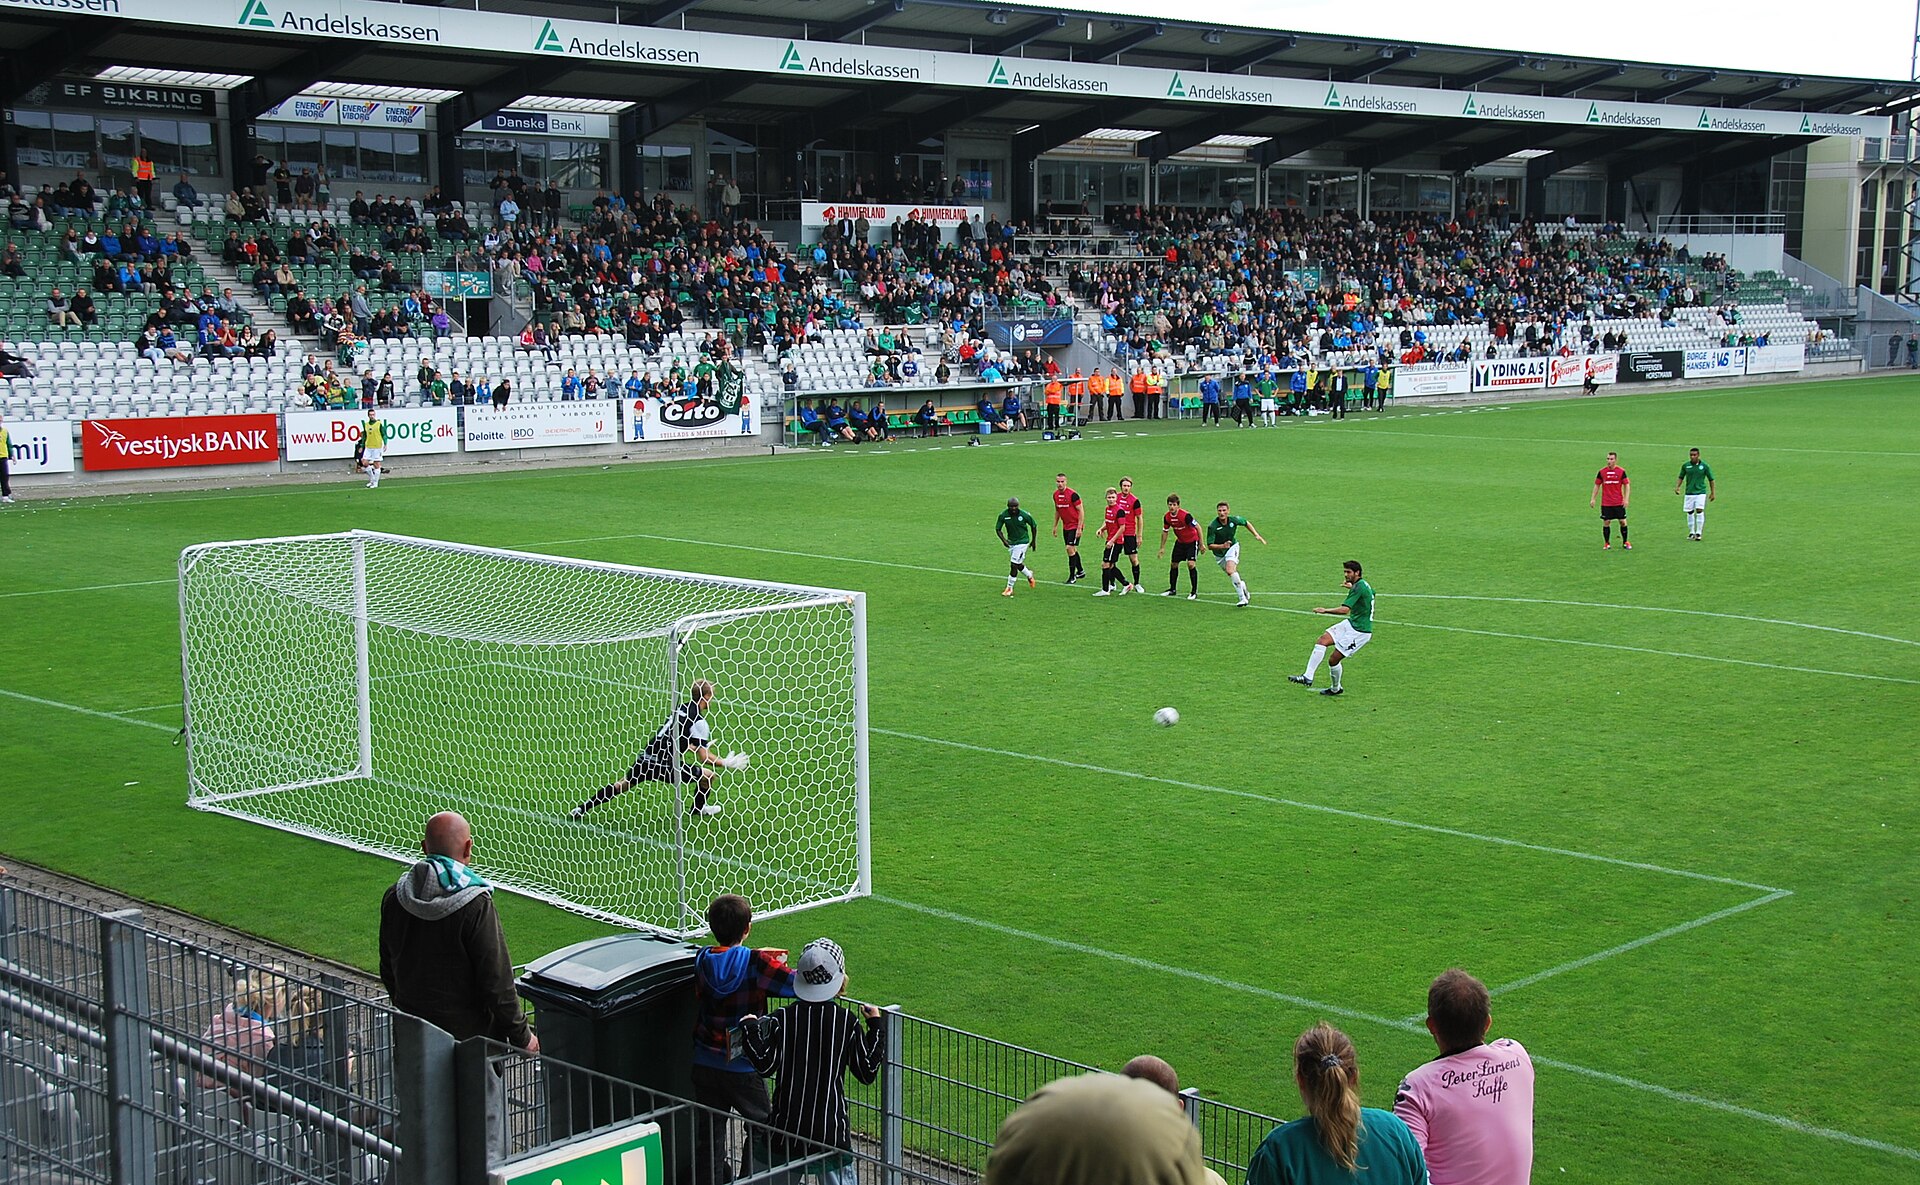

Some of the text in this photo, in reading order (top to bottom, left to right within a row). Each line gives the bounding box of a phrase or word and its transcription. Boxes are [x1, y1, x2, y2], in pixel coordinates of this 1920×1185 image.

[281, 11, 439, 42] Andelskassen
[569, 37, 699, 63] Andelskassen
[809, 57, 919, 79] Andelskassen
[1012, 72, 1107, 92] Andelskassen
[64, 84, 202, 104] EF SIKRING
[1189, 85, 1271, 103] Andelskassen
[1342, 95, 1416, 111] Andelskassen
[295, 109, 324, 118] VIBORG
[342, 112, 370, 121] VIBORG
[385, 115, 413, 124] VIBORG
[1479, 104, 1544, 120] Andelskassen
[1601, 111, 1660, 126] Andelskassen
[497, 115, 582, 131] Danske Bank
[1711, 118, 1765, 131] Andelskassen
[1812, 122, 1861, 135] Andelskassen
[838, 206, 886, 219] HIMMERLAND
[921, 208, 967, 220] HIMMERLAND
[1492, 362, 1544, 378] YDING A/S
[1686, 361, 1711, 371] HANSEN
[496, 402, 611, 412] SATSAUTORISEREDE
[664, 401, 720, 421] Cito
[478, 413, 538, 421] REVISORER
[291, 419, 454, 444] www.Boborg.dk
[513, 428, 534, 437] BDO
[660, 431, 689, 439] STILLADS
[696, 429, 727, 437] MATERIEL
[1441, 1056, 1520, 1089] Peter Larsens
[1472, 1075, 1508, 1103] Kaffe
